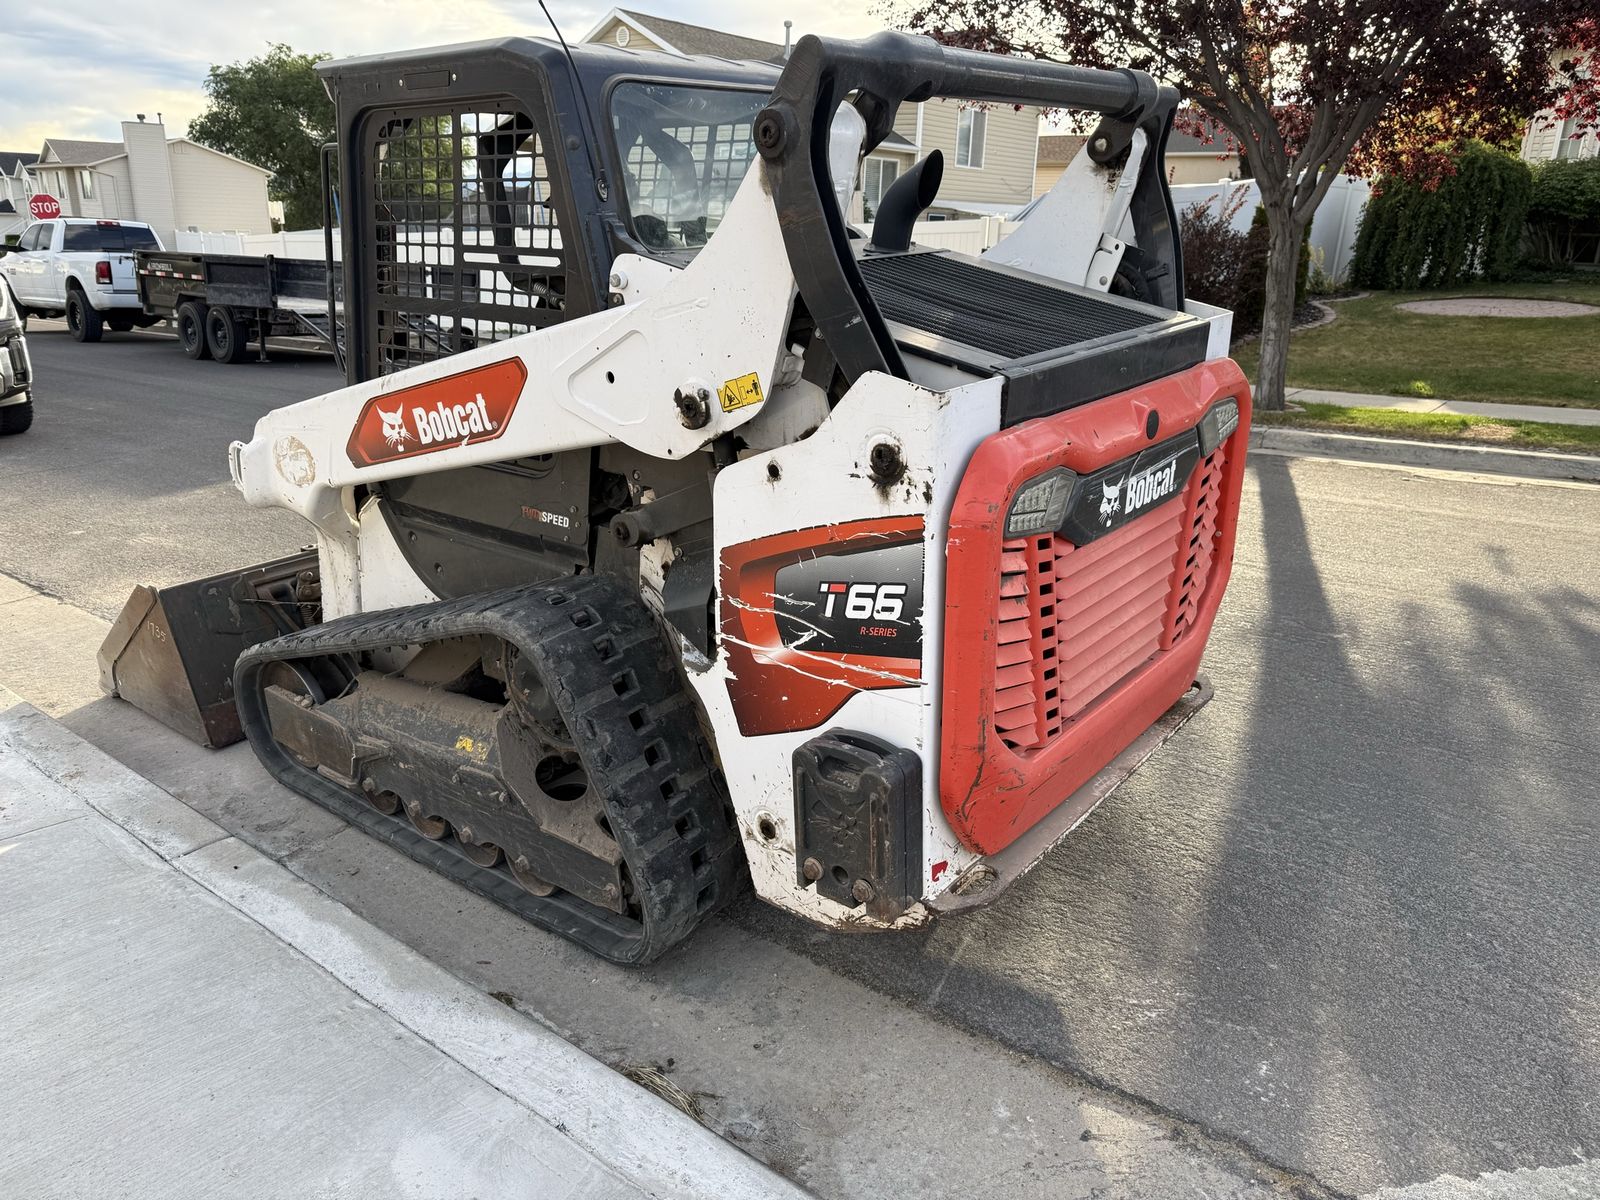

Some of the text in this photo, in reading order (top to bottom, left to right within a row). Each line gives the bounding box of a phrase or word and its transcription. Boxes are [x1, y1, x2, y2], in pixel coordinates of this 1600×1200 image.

[30, 202, 59, 214] STOP
[412, 393, 492, 445] Bobcat
[1125, 459, 1177, 515] Bobcat
[819, 583, 907, 621] T66
[859, 625, 898, 638] R-SERIES
